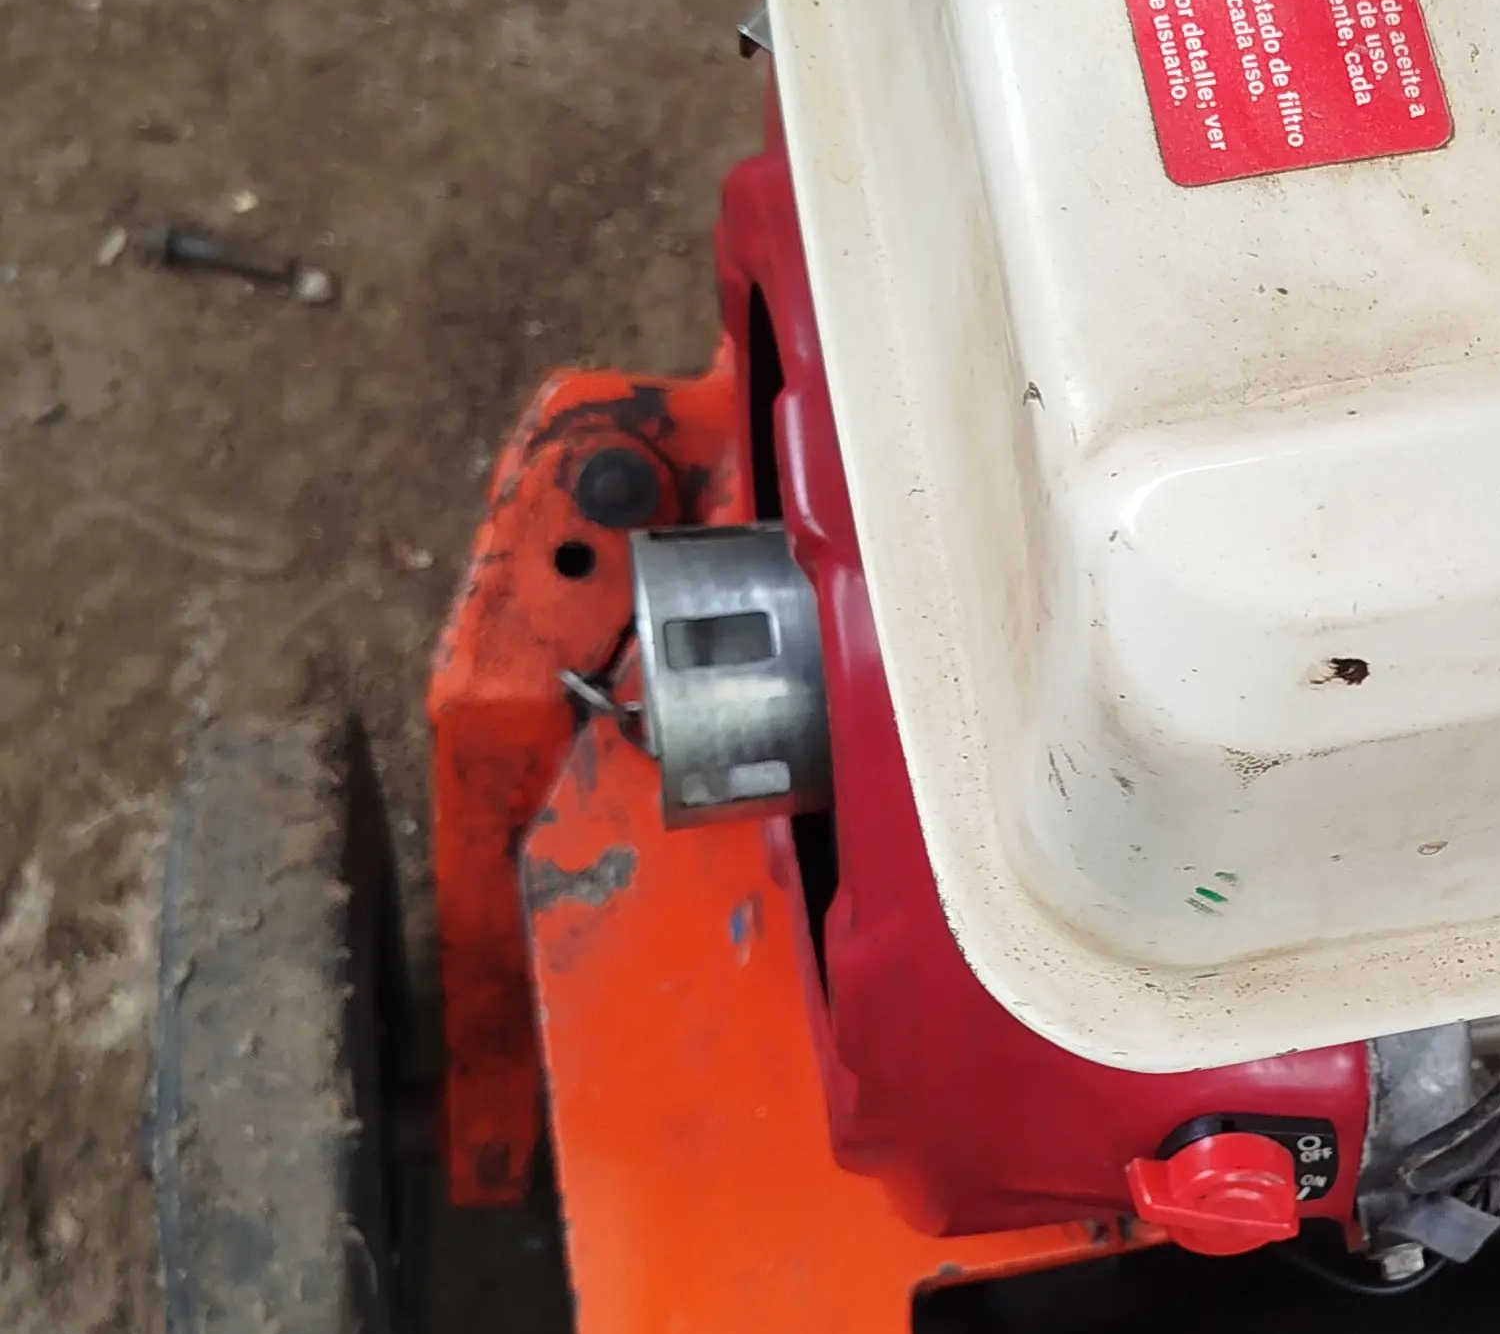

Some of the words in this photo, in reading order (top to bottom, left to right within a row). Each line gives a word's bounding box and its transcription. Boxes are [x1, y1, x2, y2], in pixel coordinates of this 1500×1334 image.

[1357, 1, 1377, 28] de
[1381, 0, 1402, 25] de
[1154, 15, 1189, 105] usuario.
[1242, 54, 1264, 101] uso.
[1269, 58, 1291, 86] de
[1345, 52, 1373, 105] cada
[1365, 34, 1388, 80] uso.
[1390, 32, 1420, 97] aceite
[1205, 115, 1226, 150] ver
[1277, 91, 1303, 147] filtro
[1409, 104, 1425, 117] a
